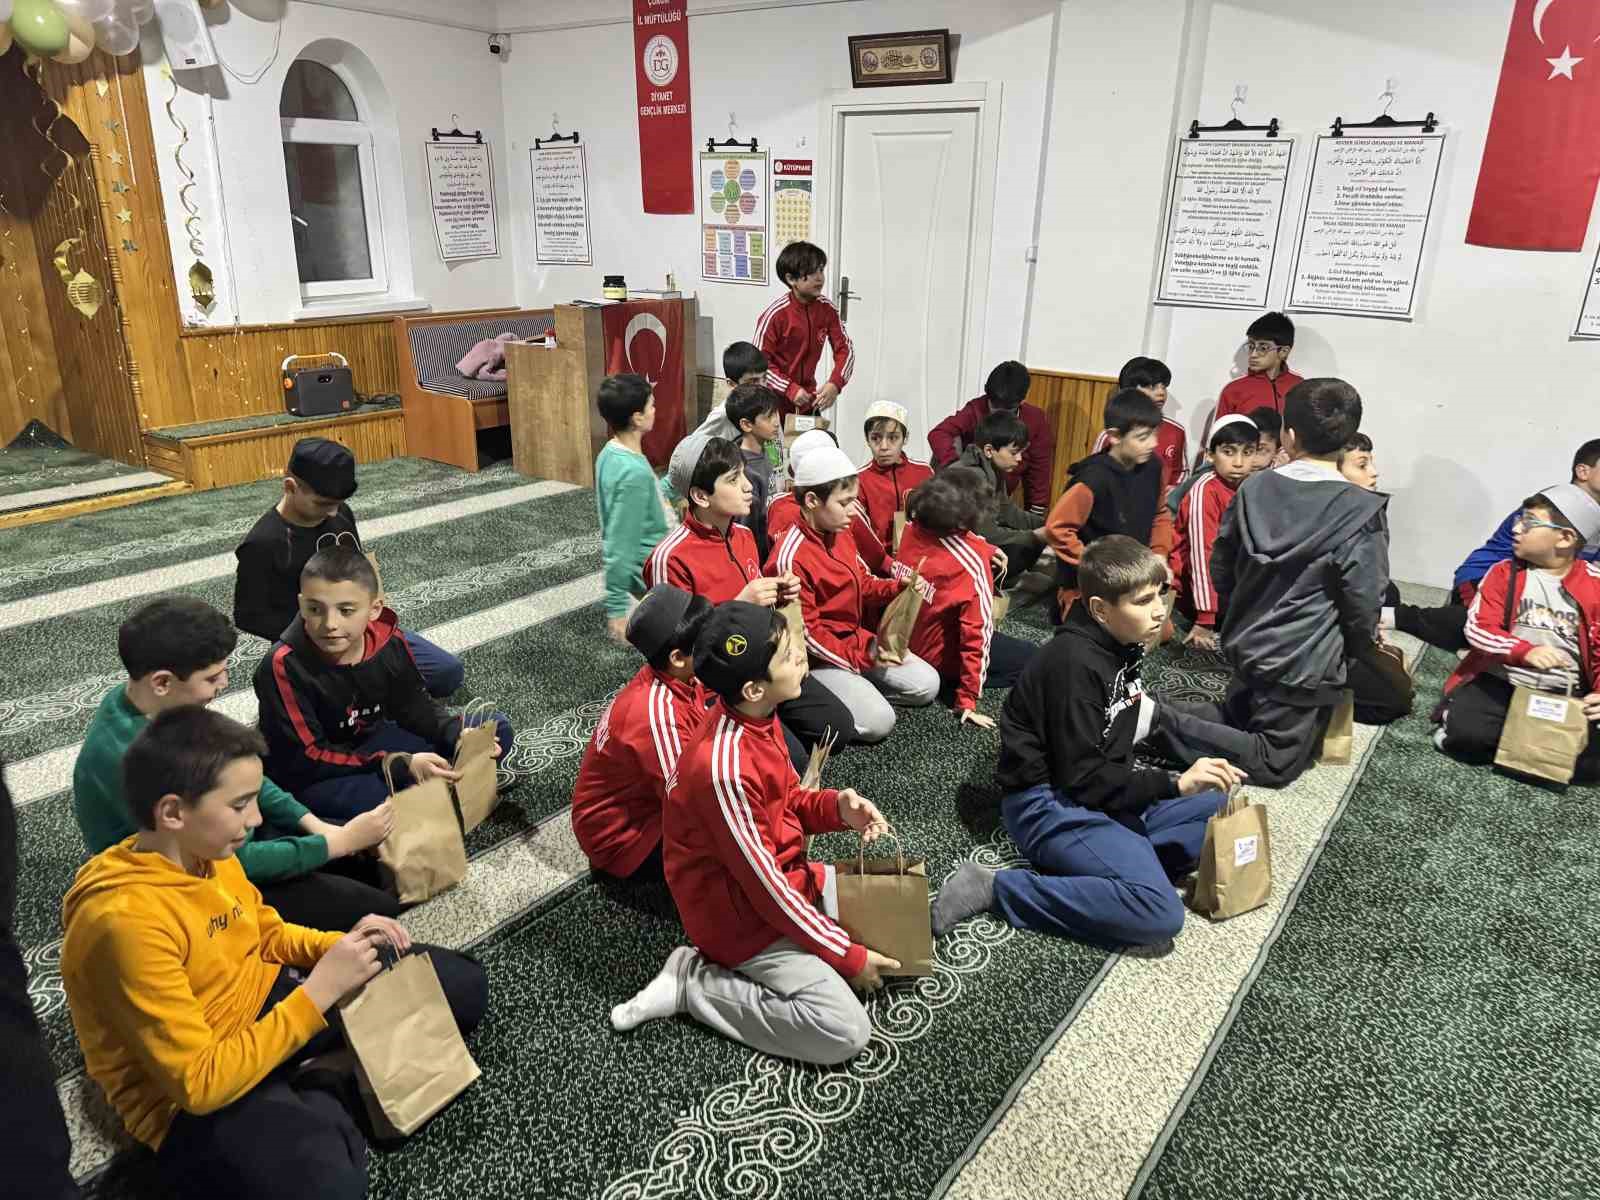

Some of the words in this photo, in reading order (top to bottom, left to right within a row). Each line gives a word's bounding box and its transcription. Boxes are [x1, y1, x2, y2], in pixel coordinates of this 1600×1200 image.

[650, 91, 673, 103] DİYANET
[640, 106, 662, 118] GENÇLİK
[663, 104, 688, 116] MERKEZİ
